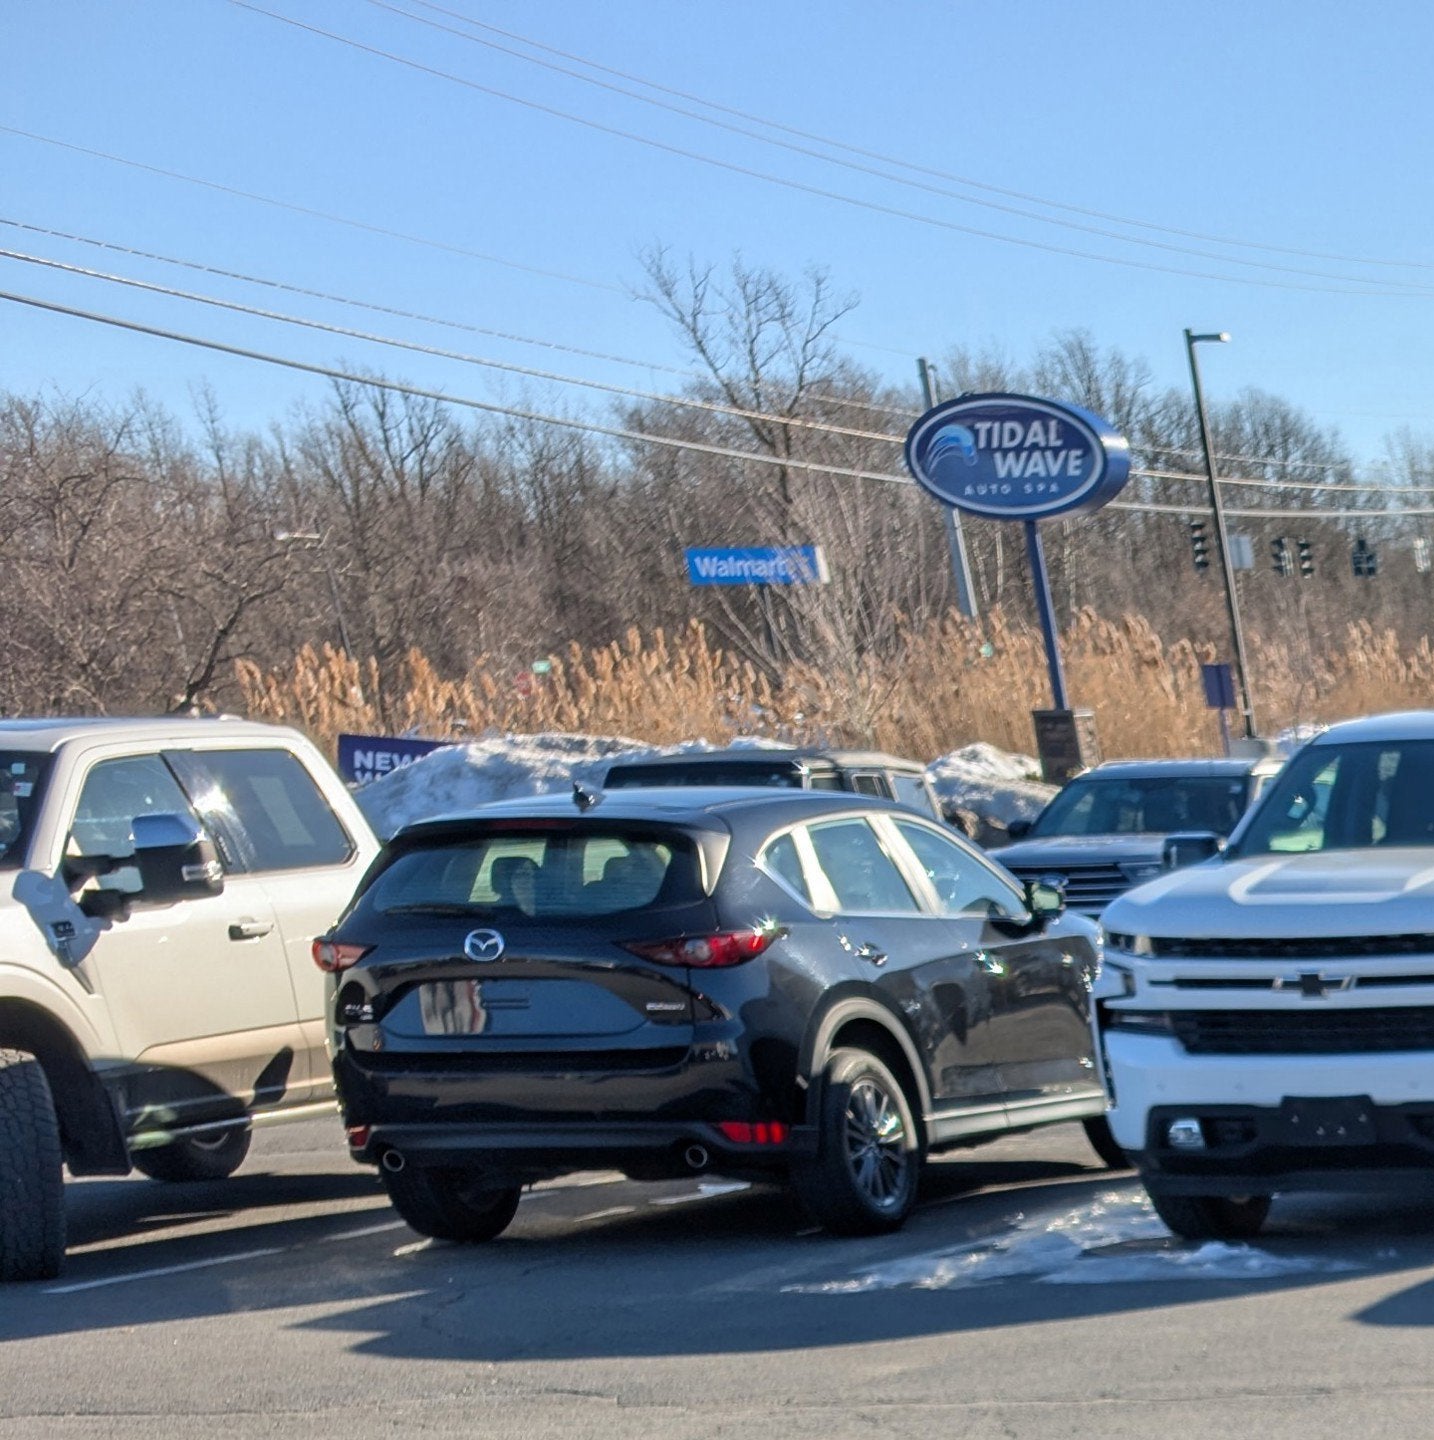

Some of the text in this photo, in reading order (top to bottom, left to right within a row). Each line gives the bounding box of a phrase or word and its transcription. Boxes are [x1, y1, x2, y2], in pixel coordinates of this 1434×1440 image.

[974, 420, 1064, 449] TIDAL
[993, 448, 1084, 479] WAVE
[964, 482, 1060, 496] AUTO SPA
[694, 556, 788, 578] Walmart
